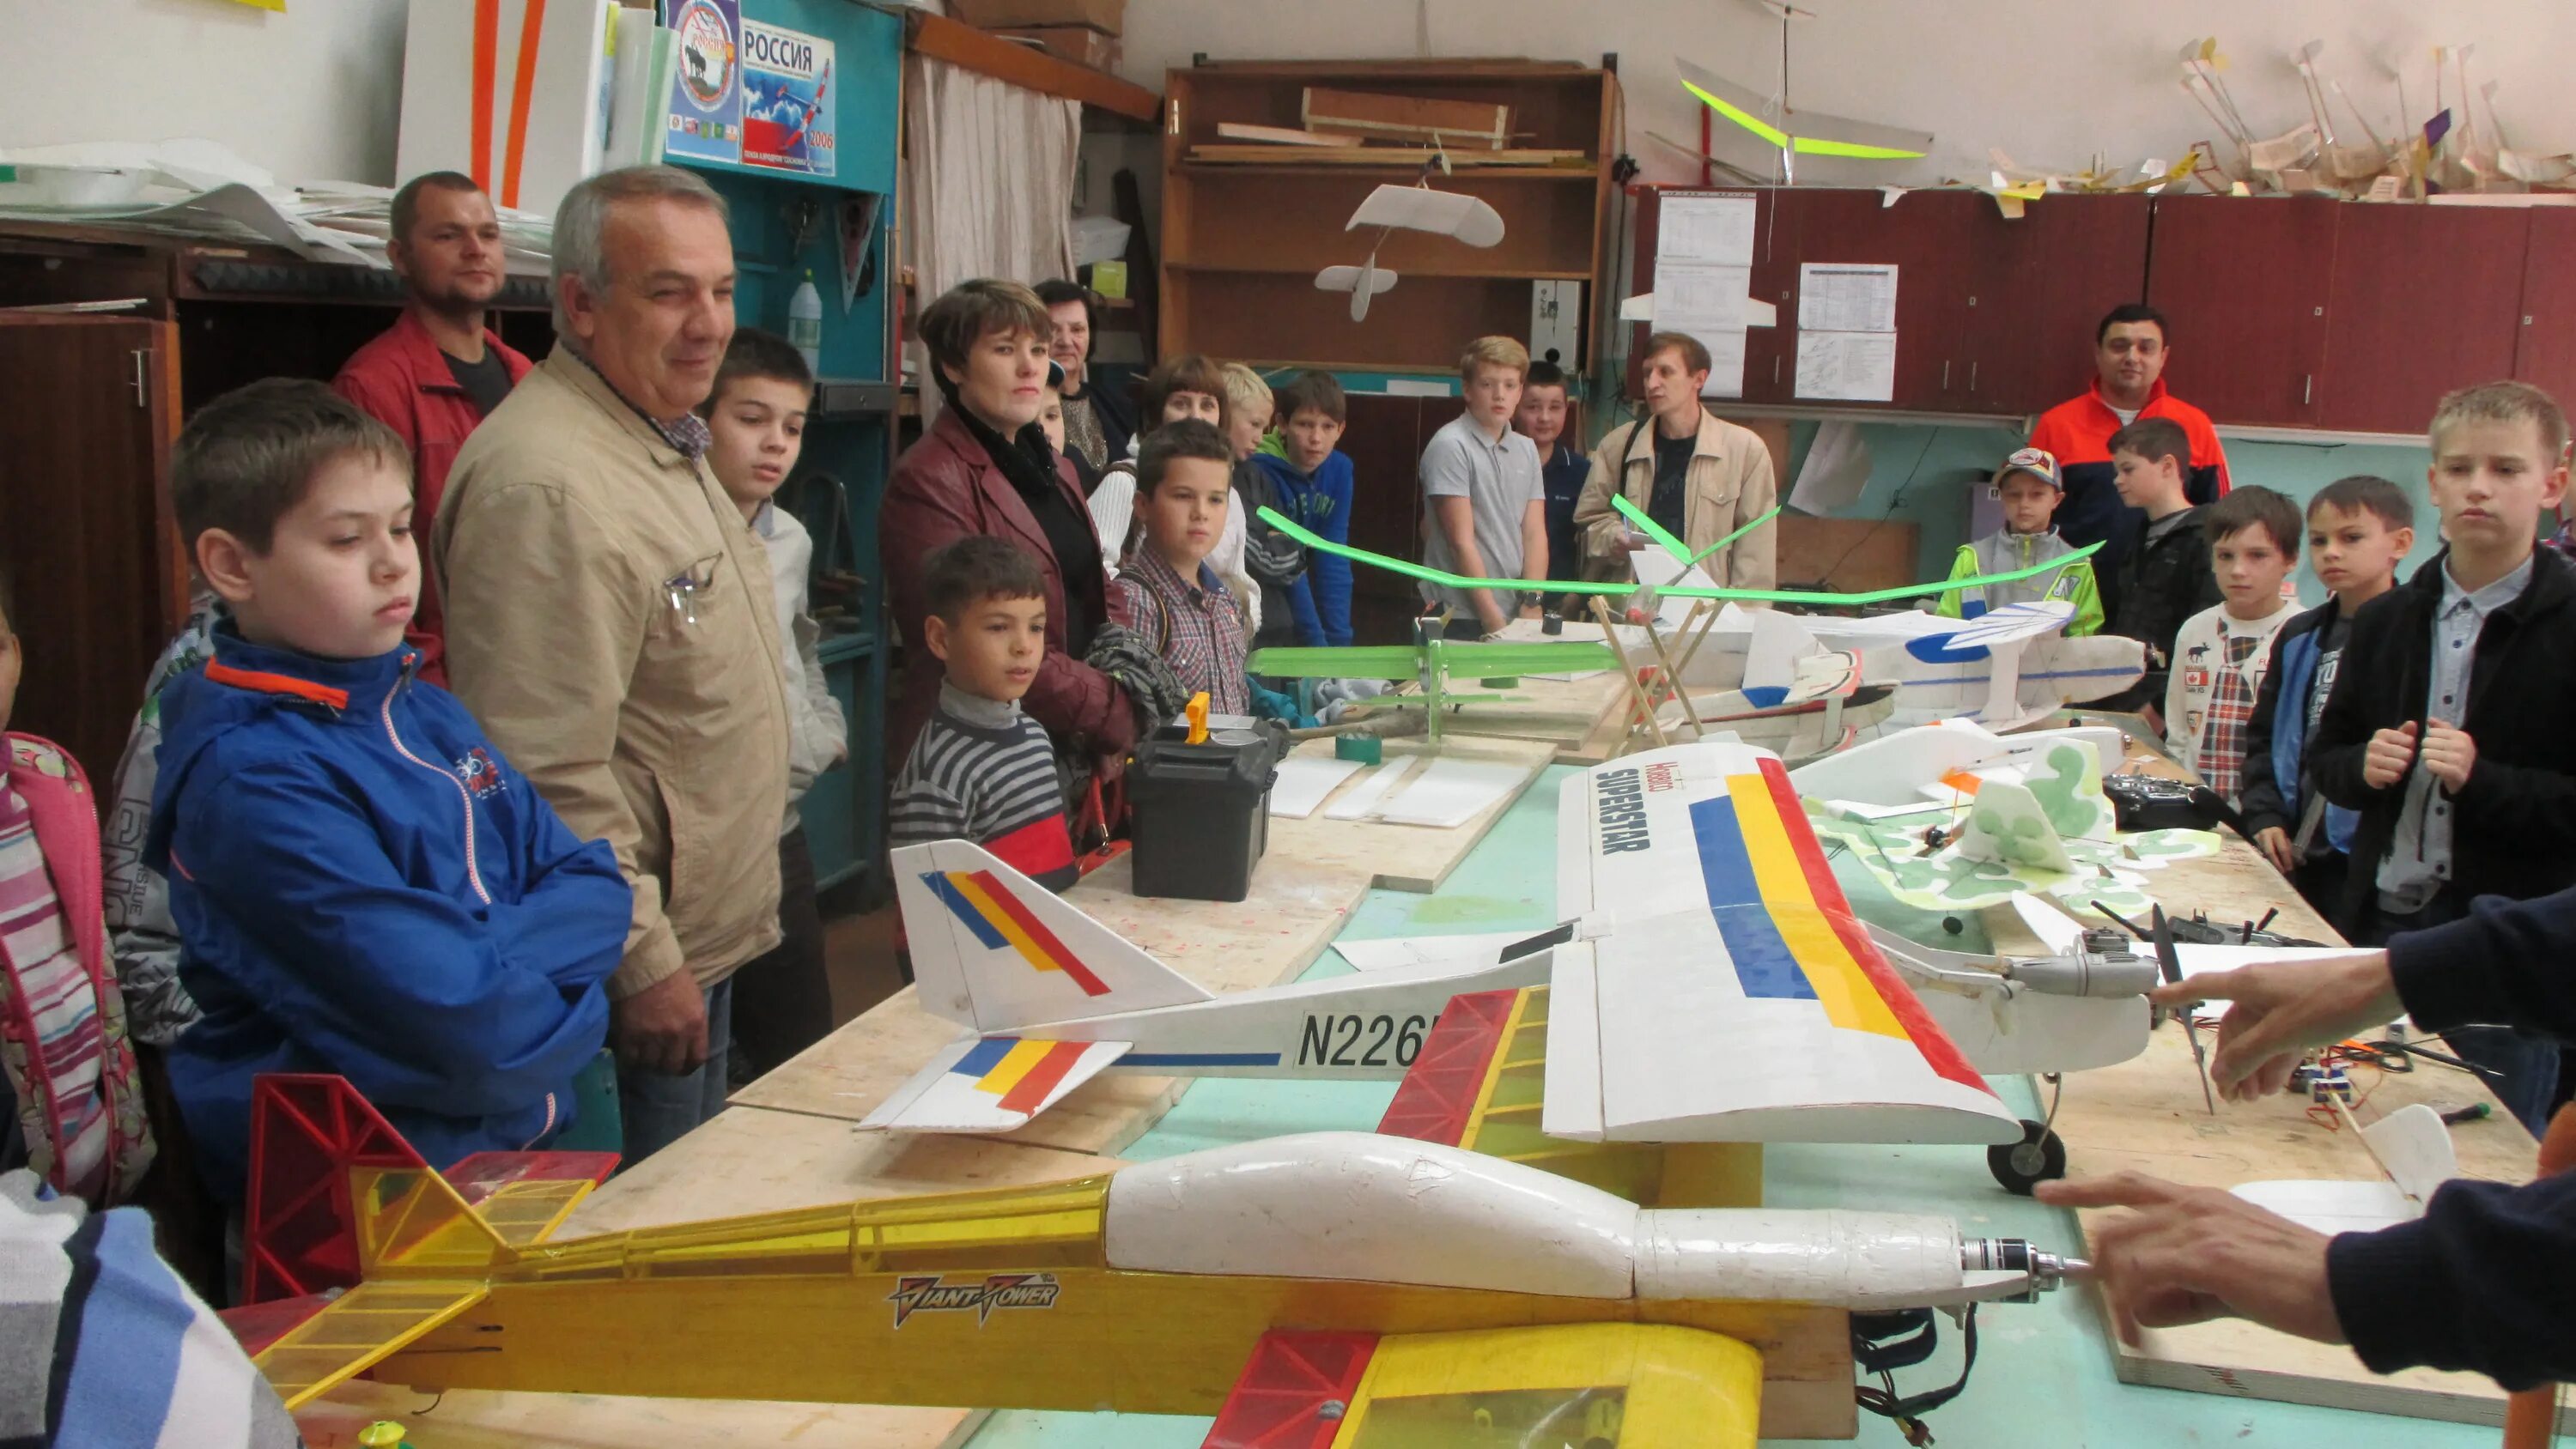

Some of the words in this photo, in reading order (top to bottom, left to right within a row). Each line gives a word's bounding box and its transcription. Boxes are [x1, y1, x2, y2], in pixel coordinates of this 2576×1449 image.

[744, 30, 811, 72] РОССИЯ
[811, 130, 833, 149] 2006
[1645, 761, 1679, 792] HOBBICO
[1595, 768, 1650, 856] SUPERSTAR
[1298, 1015, 1441, 1067] N226
